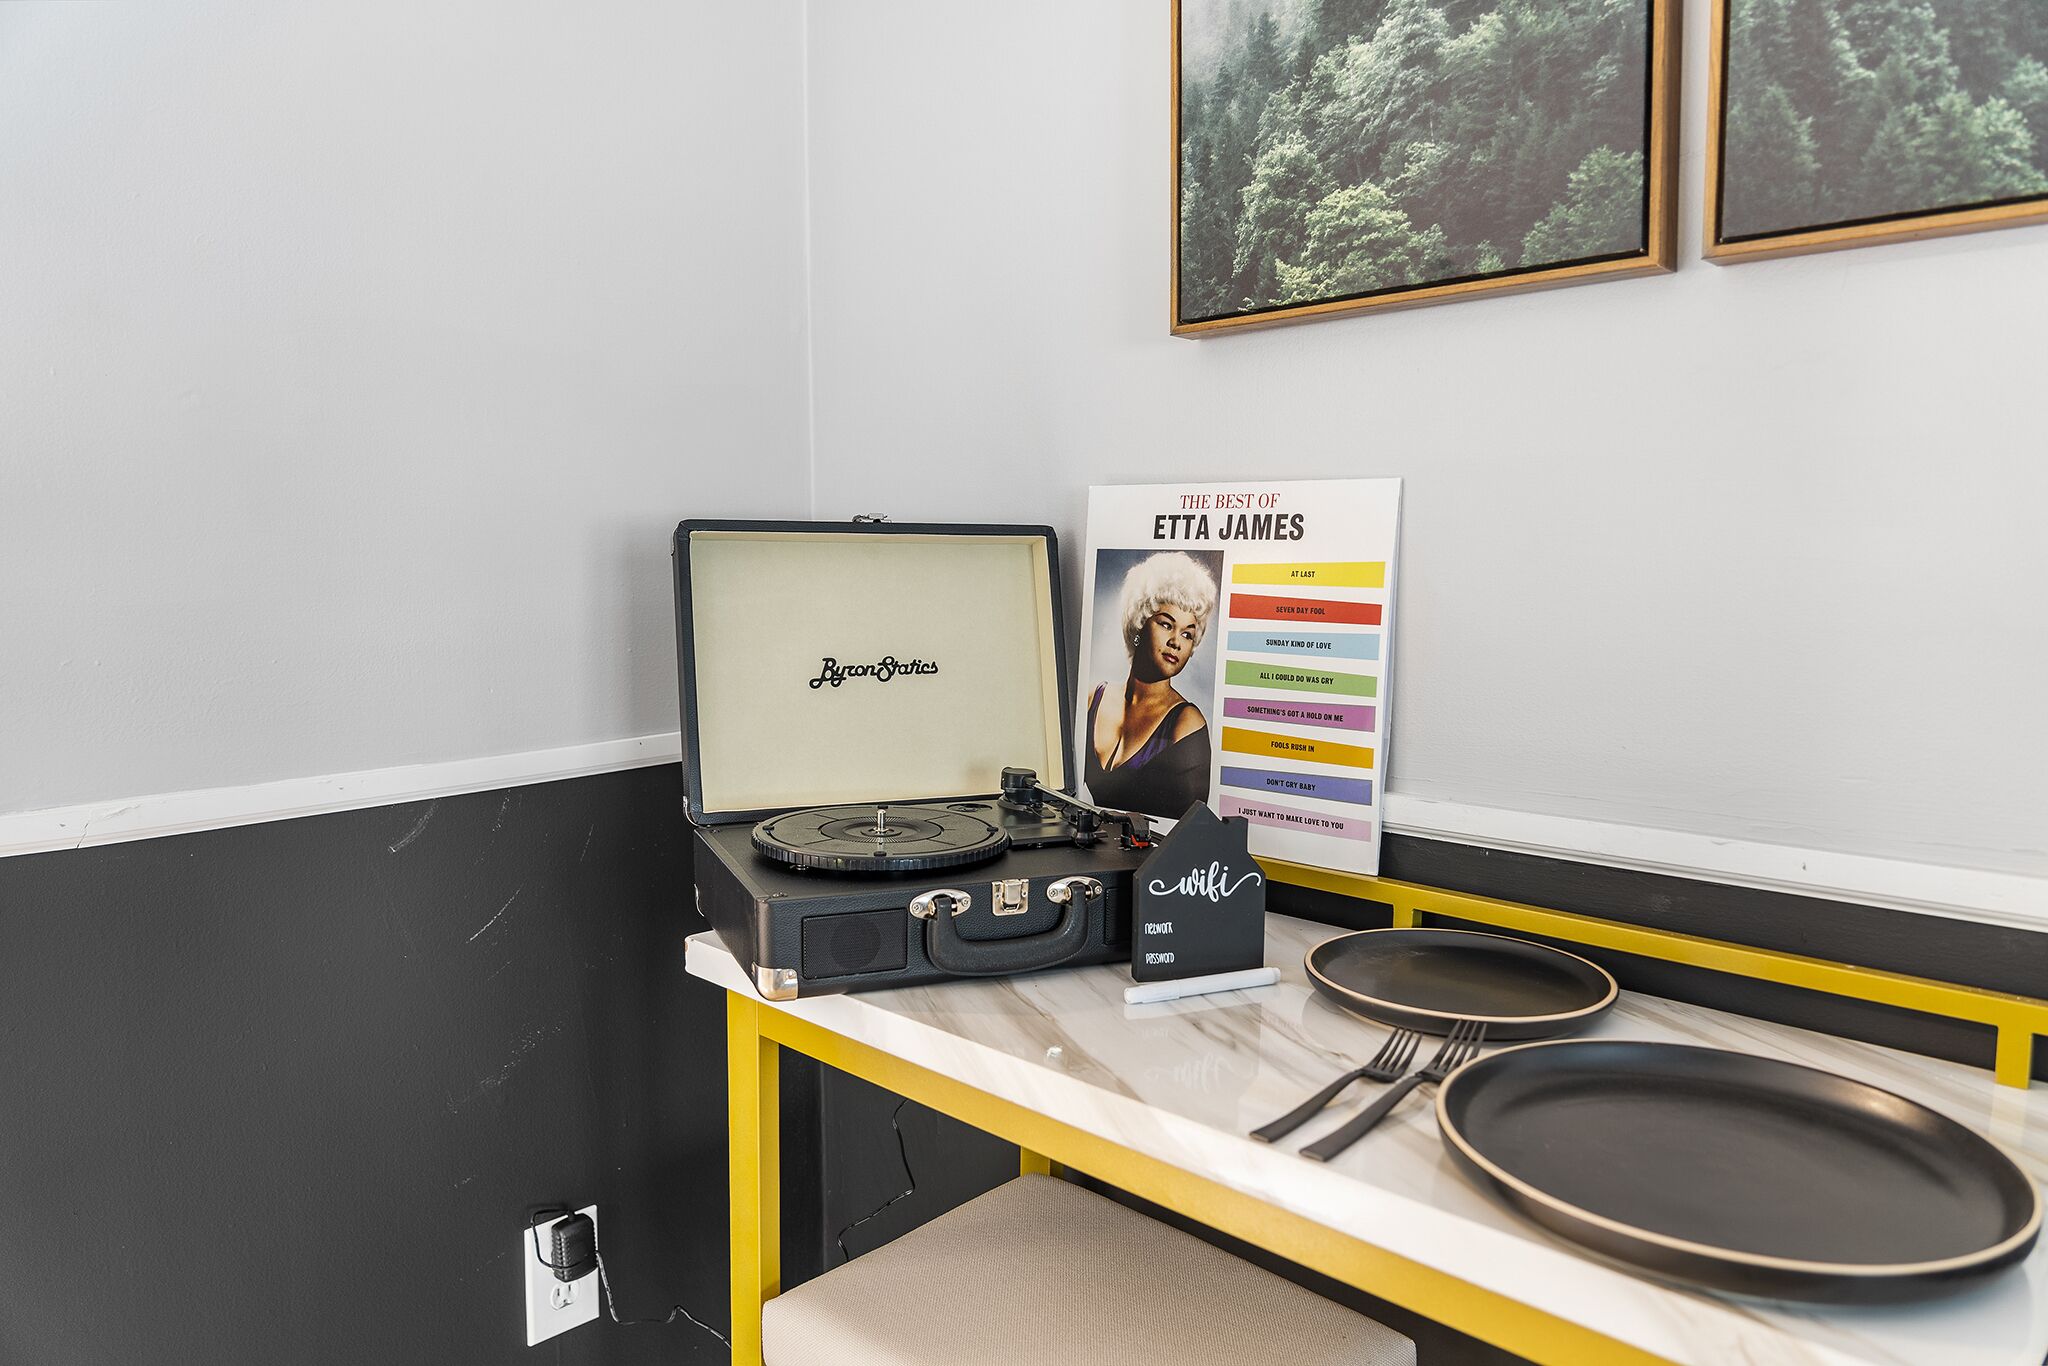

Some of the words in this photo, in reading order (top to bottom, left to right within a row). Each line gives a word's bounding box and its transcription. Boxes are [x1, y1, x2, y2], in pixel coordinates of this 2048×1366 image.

[1180, 494, 1210, 509] THE
[1216, 494, 1254, 509] BEST
[1258, 493, 1280, 508] OF
[1154, 514, 1209, 540] ETTA
[1218, 513, 1304, 540] JAMES
[1300, 570, 1315, 578] LAST
[1276, 606, 1294, 614] SEVEN
[1296, 606, 1309, 615] DAY
[1310, 607, 1325, 615] FOOL
[1266, 638, 1289, 647] SUNDAY
[1290, 640, 1305, 648] KIND
[1306, 640, 1314, 649] OF
[1315, 641, 1331, 650] LOVE
[1260, 672, 1270, 680] ALL
[1321, 677, 1334, 685] CRY
[1247, 706, 1286, 716] SOMETHING'S
[1287, 710, 1299, 718] GOT
[1306, 711, 1322, 720] HOLD
[1324, 713, 1333, 721] ON
[1334, 714, 1343, 722] ME
[1271, 741, 1289, 749] FOOLS
[1291, 743, 1307, 751] RUSH
[1267, 779, 1284, 787] DON'T
[1286, 781, 1298, 789] CRY
[1299, 783, 1315, 791] BABY
[1242, 808, 1256, 816] JUST
[1258, 811, 1275, 819] WANT
[1286, 815, 1303, 823] MAKE
[1305, 817, 1320, 826] LOVE
[1331, 822, 1344, 830] YOU
[1149, 861, 1261, 902] wifi
